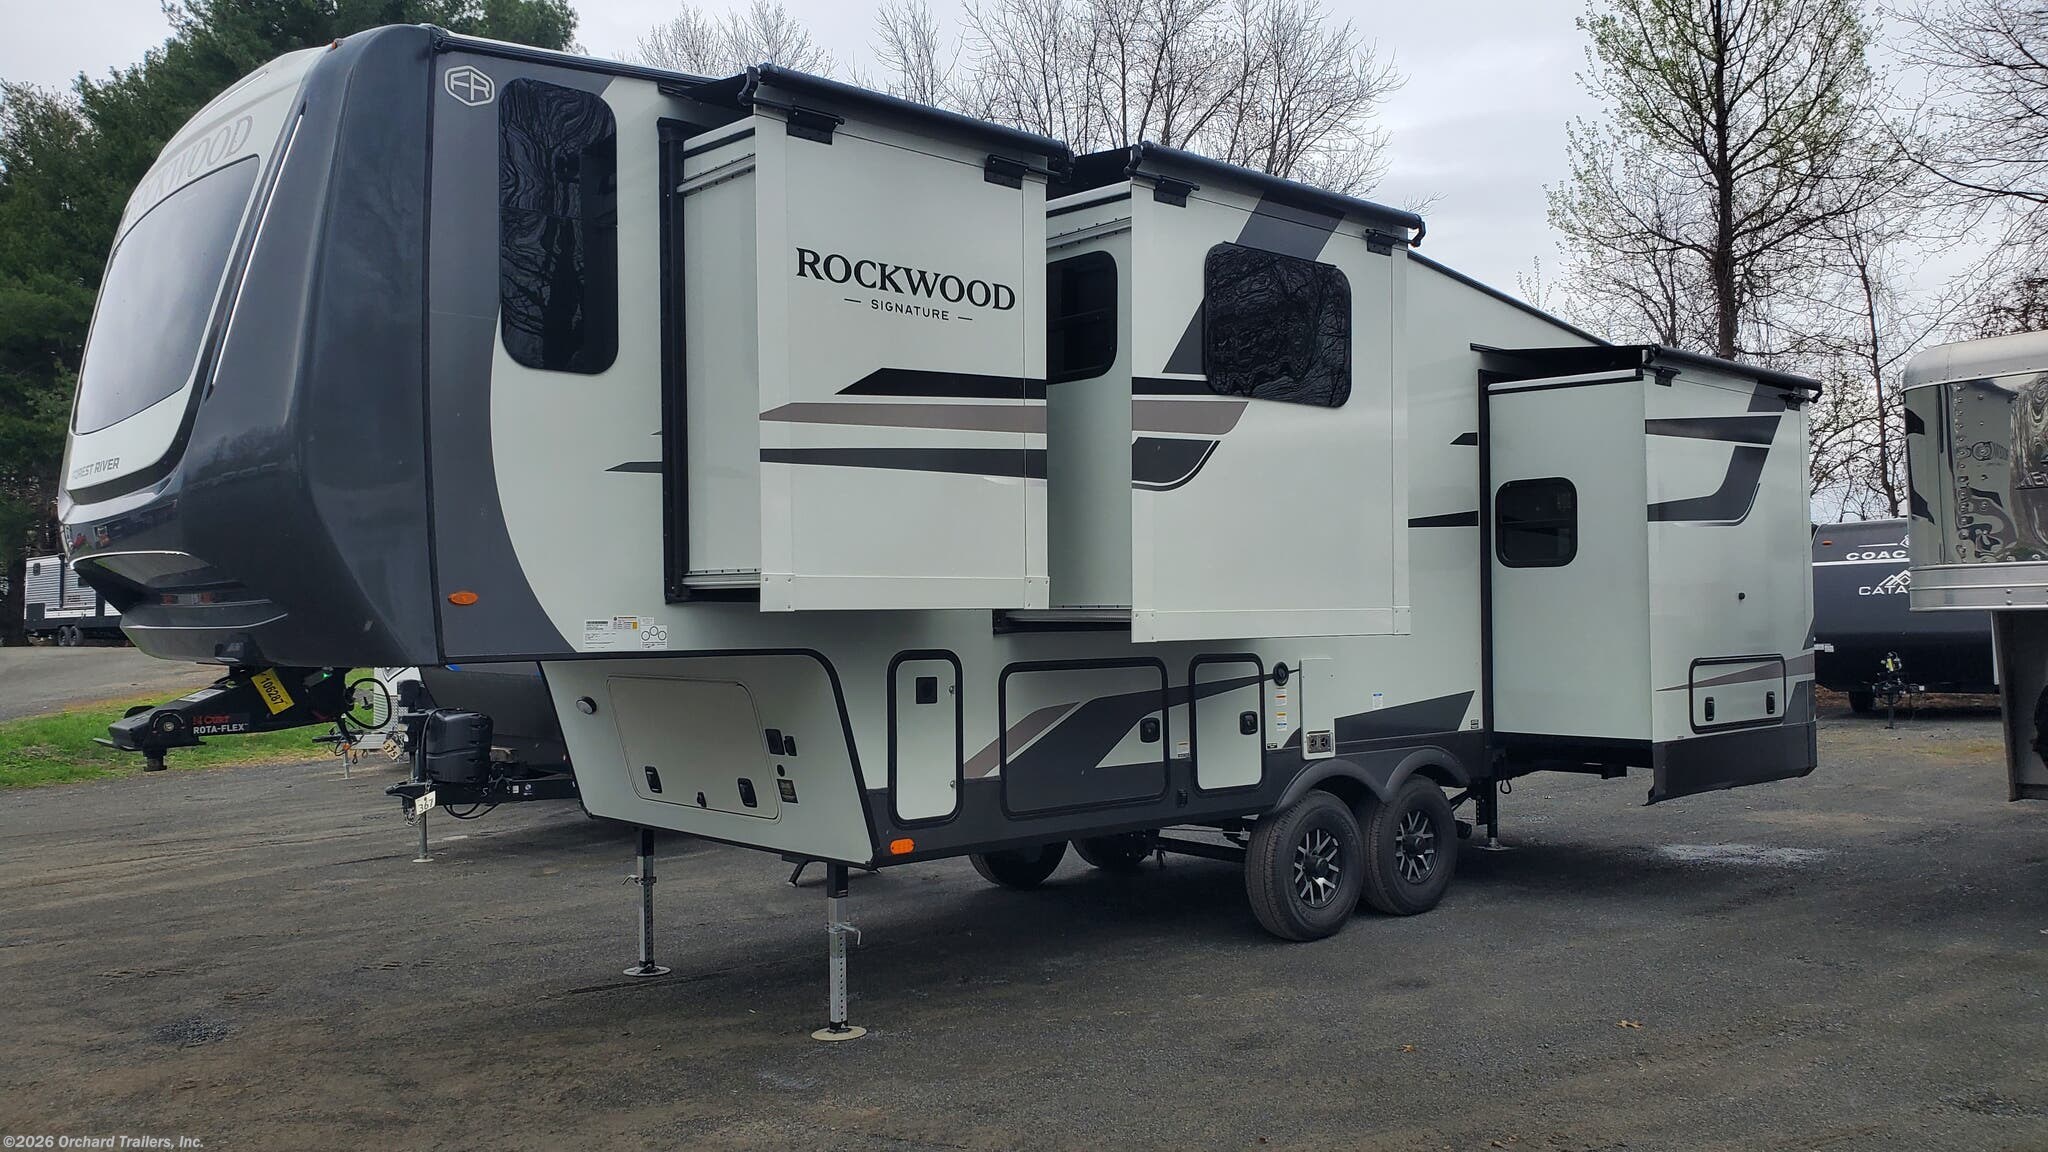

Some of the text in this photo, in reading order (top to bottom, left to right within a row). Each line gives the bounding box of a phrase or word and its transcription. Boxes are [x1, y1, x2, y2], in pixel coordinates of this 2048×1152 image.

[450, 71, 490, 101] FR
[796, 247, 1016, 311] ROCKWOOD
[871, 299, 949, 321] SIGNATURE
[94, 457, 120, 474] RIVER
[260, 678, 285, 705] 106287
[418, 798, 434, 813] 367
